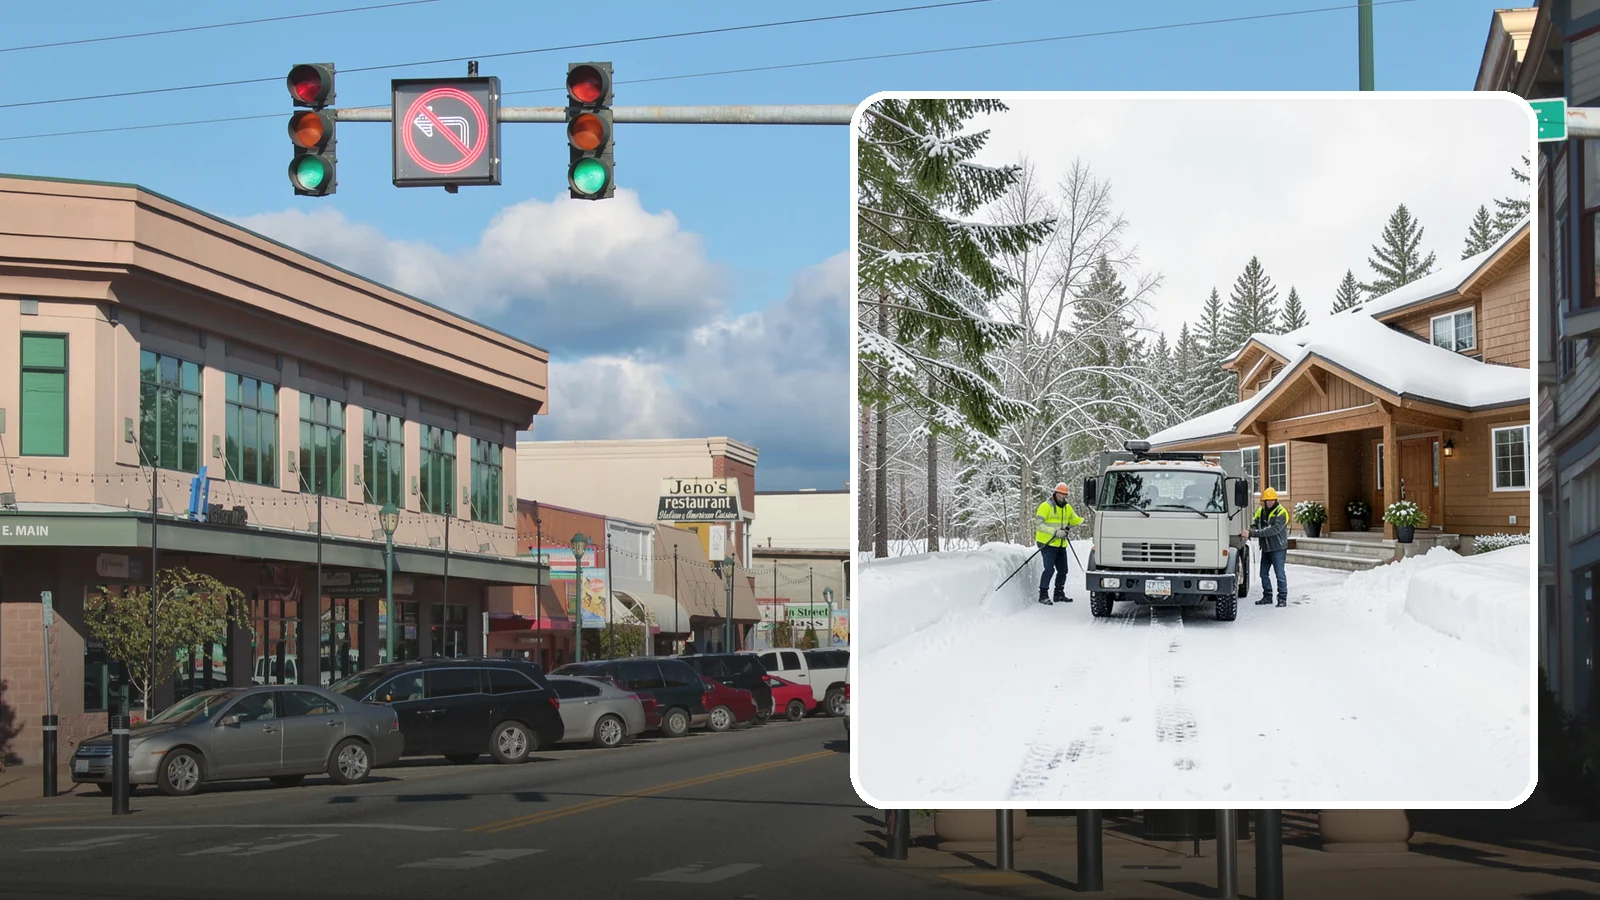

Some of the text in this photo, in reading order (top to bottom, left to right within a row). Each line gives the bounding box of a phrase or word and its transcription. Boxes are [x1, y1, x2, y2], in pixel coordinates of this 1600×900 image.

[670, 480, 727, 494] Jeno's
[665, 496, 731, 509] restaurant
[658, 510, 681, 519] Italian
[686, 510, 714, 519] American
[715, 509, 738, 519] Cuisine
[2, 525, 49, 536] E. MAIN
[797, 607, 828, 617] Street
